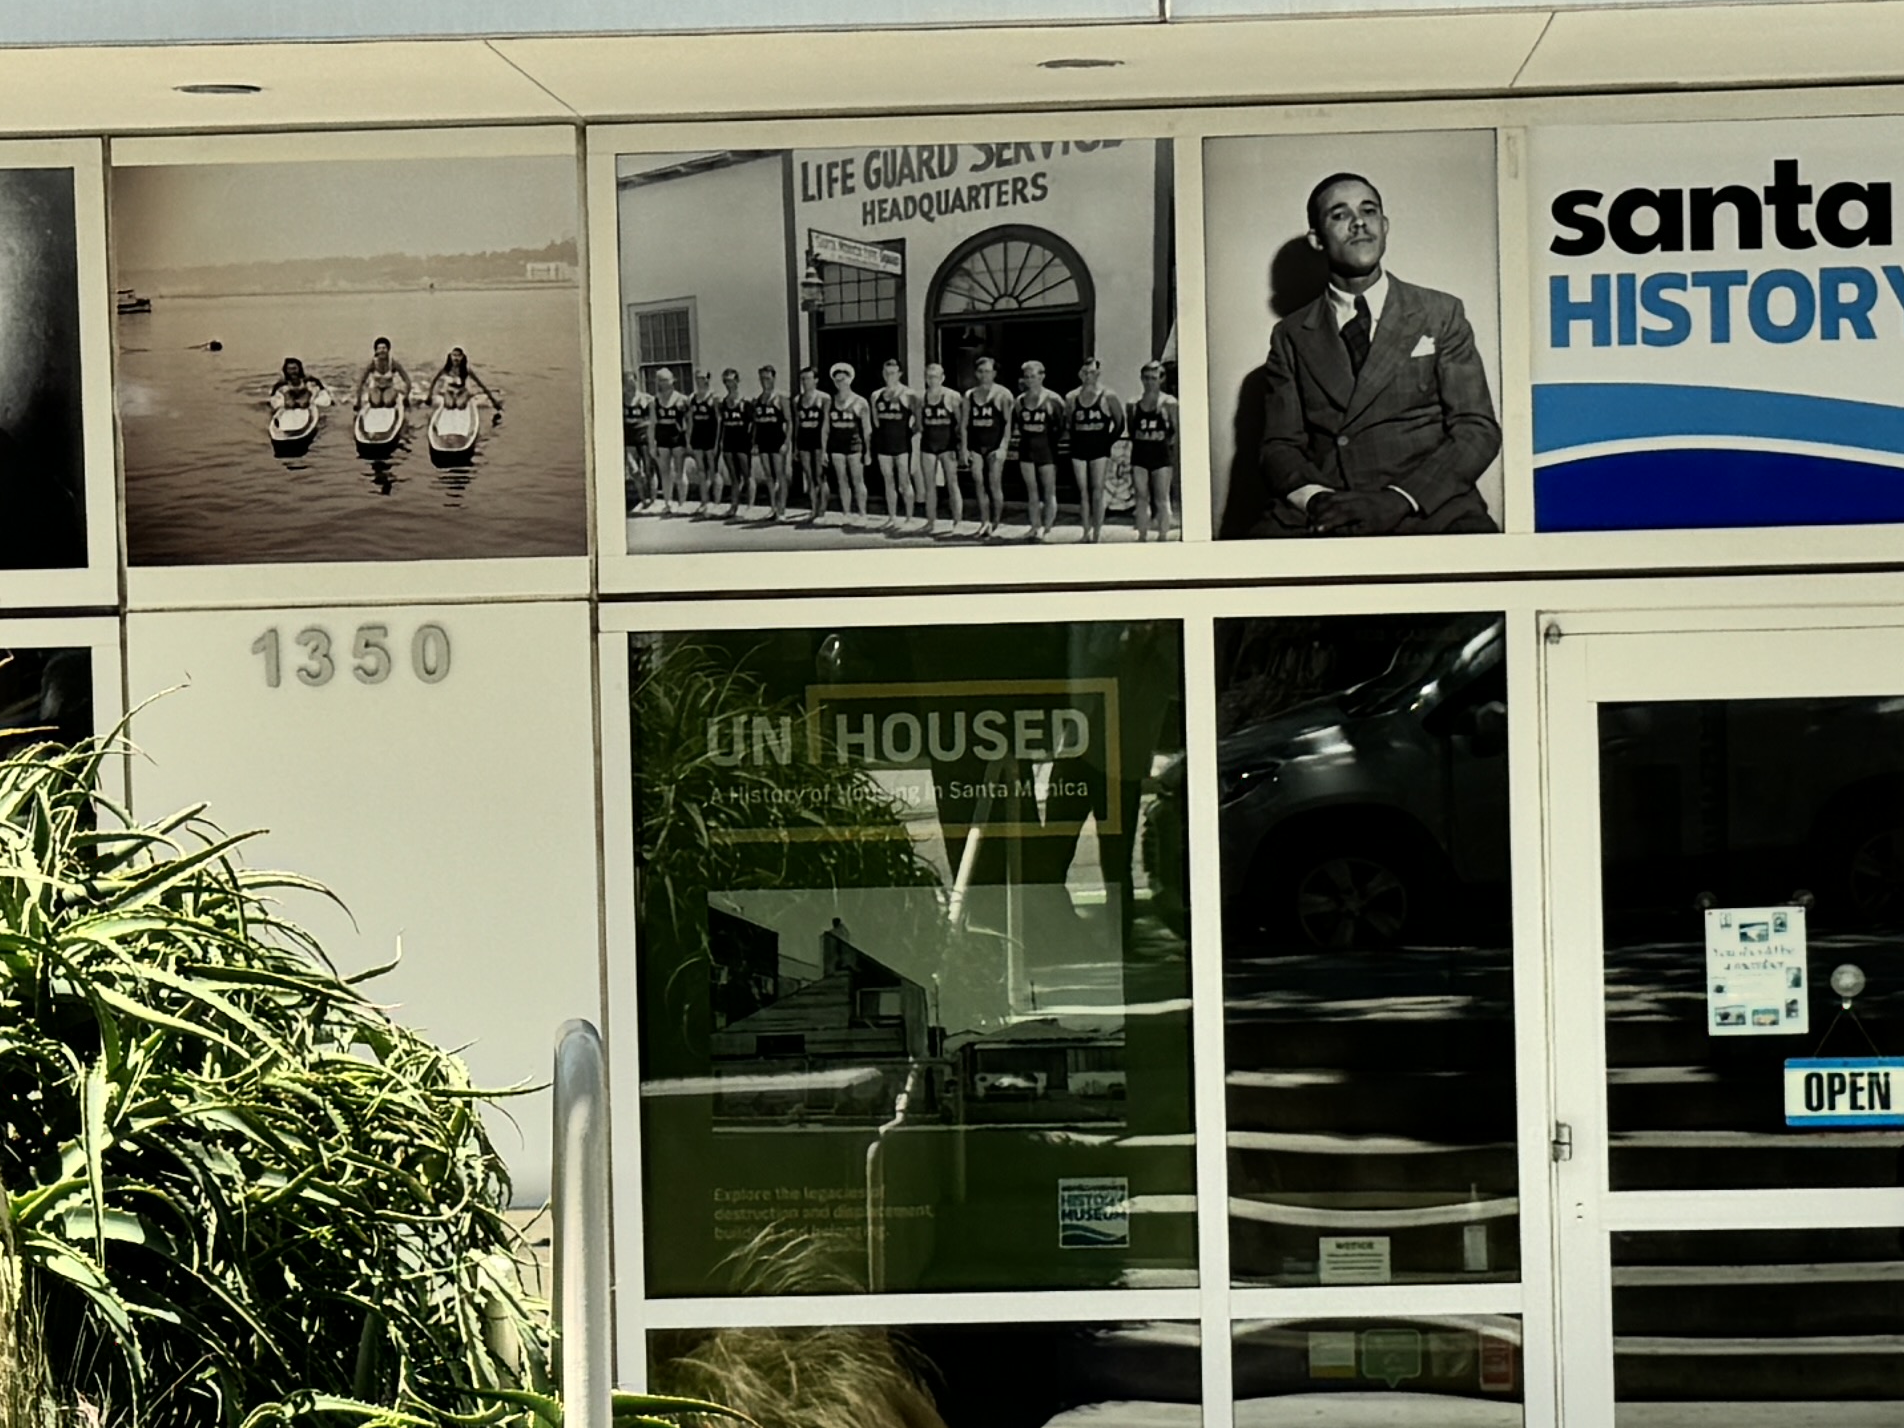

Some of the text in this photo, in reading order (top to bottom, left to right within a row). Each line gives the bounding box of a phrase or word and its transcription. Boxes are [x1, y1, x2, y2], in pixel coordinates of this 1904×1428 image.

[800, 157, 856, 203] LIFE
[863, 143, 959, 192] GUARD
[861, 172, 1049, 227] HEADQUARTERS
[1549, 158, 1892, 256] santa
[251, 624, 451, 688] 1350
[706, 709, 1090, 767] UN HOUSED
[950, 779, 1008, 798] Santa
[1015, 777, 1088, 797] Mnica
[1804, 1072, 1891, 1112] OPEN
